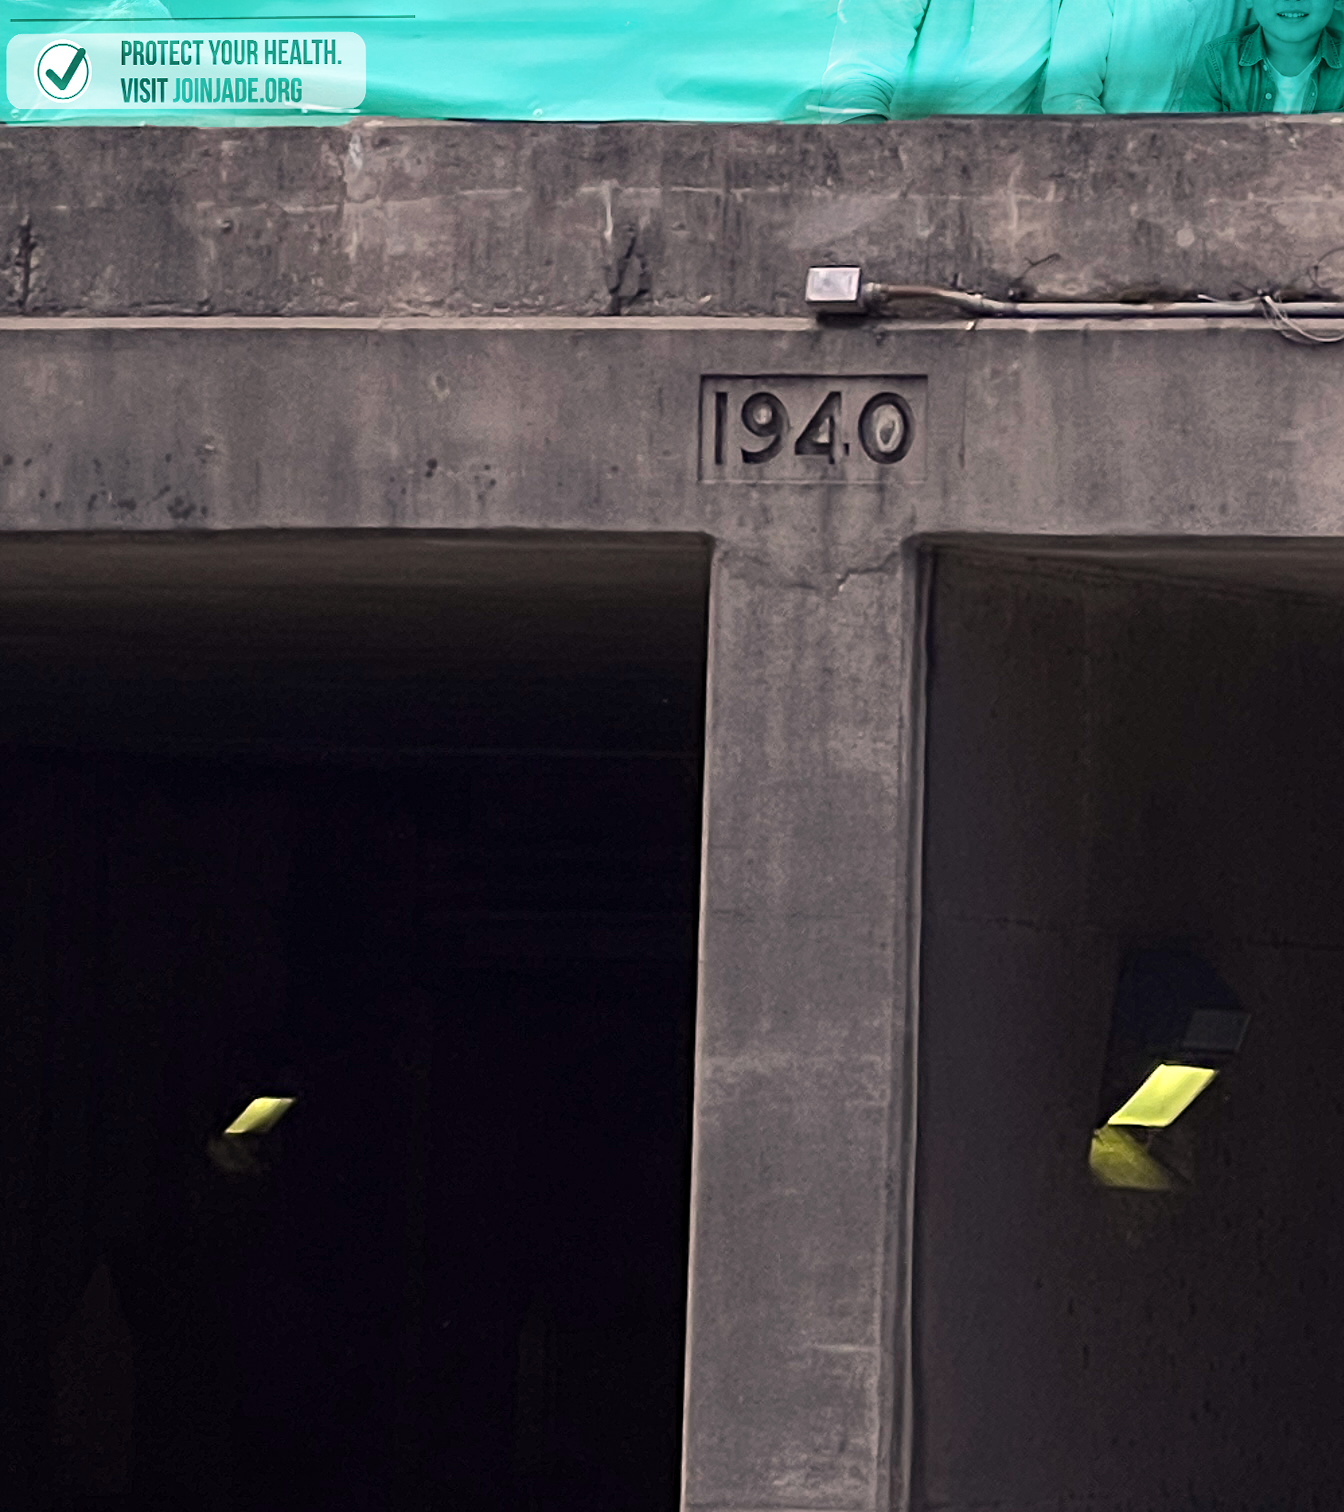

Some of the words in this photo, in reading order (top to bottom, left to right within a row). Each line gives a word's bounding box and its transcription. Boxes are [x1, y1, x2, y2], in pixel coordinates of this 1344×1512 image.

[120, 39, 204, 66] PROTECT
[208, 39, 259, 66] YOUR
[264, 38, 342, 65] HEALTH.
[120, 77, 169, 104] VISIT
[172, 77, 303, 104] JOINJADE.ORG
[713, 390, 916, 466] 1940
